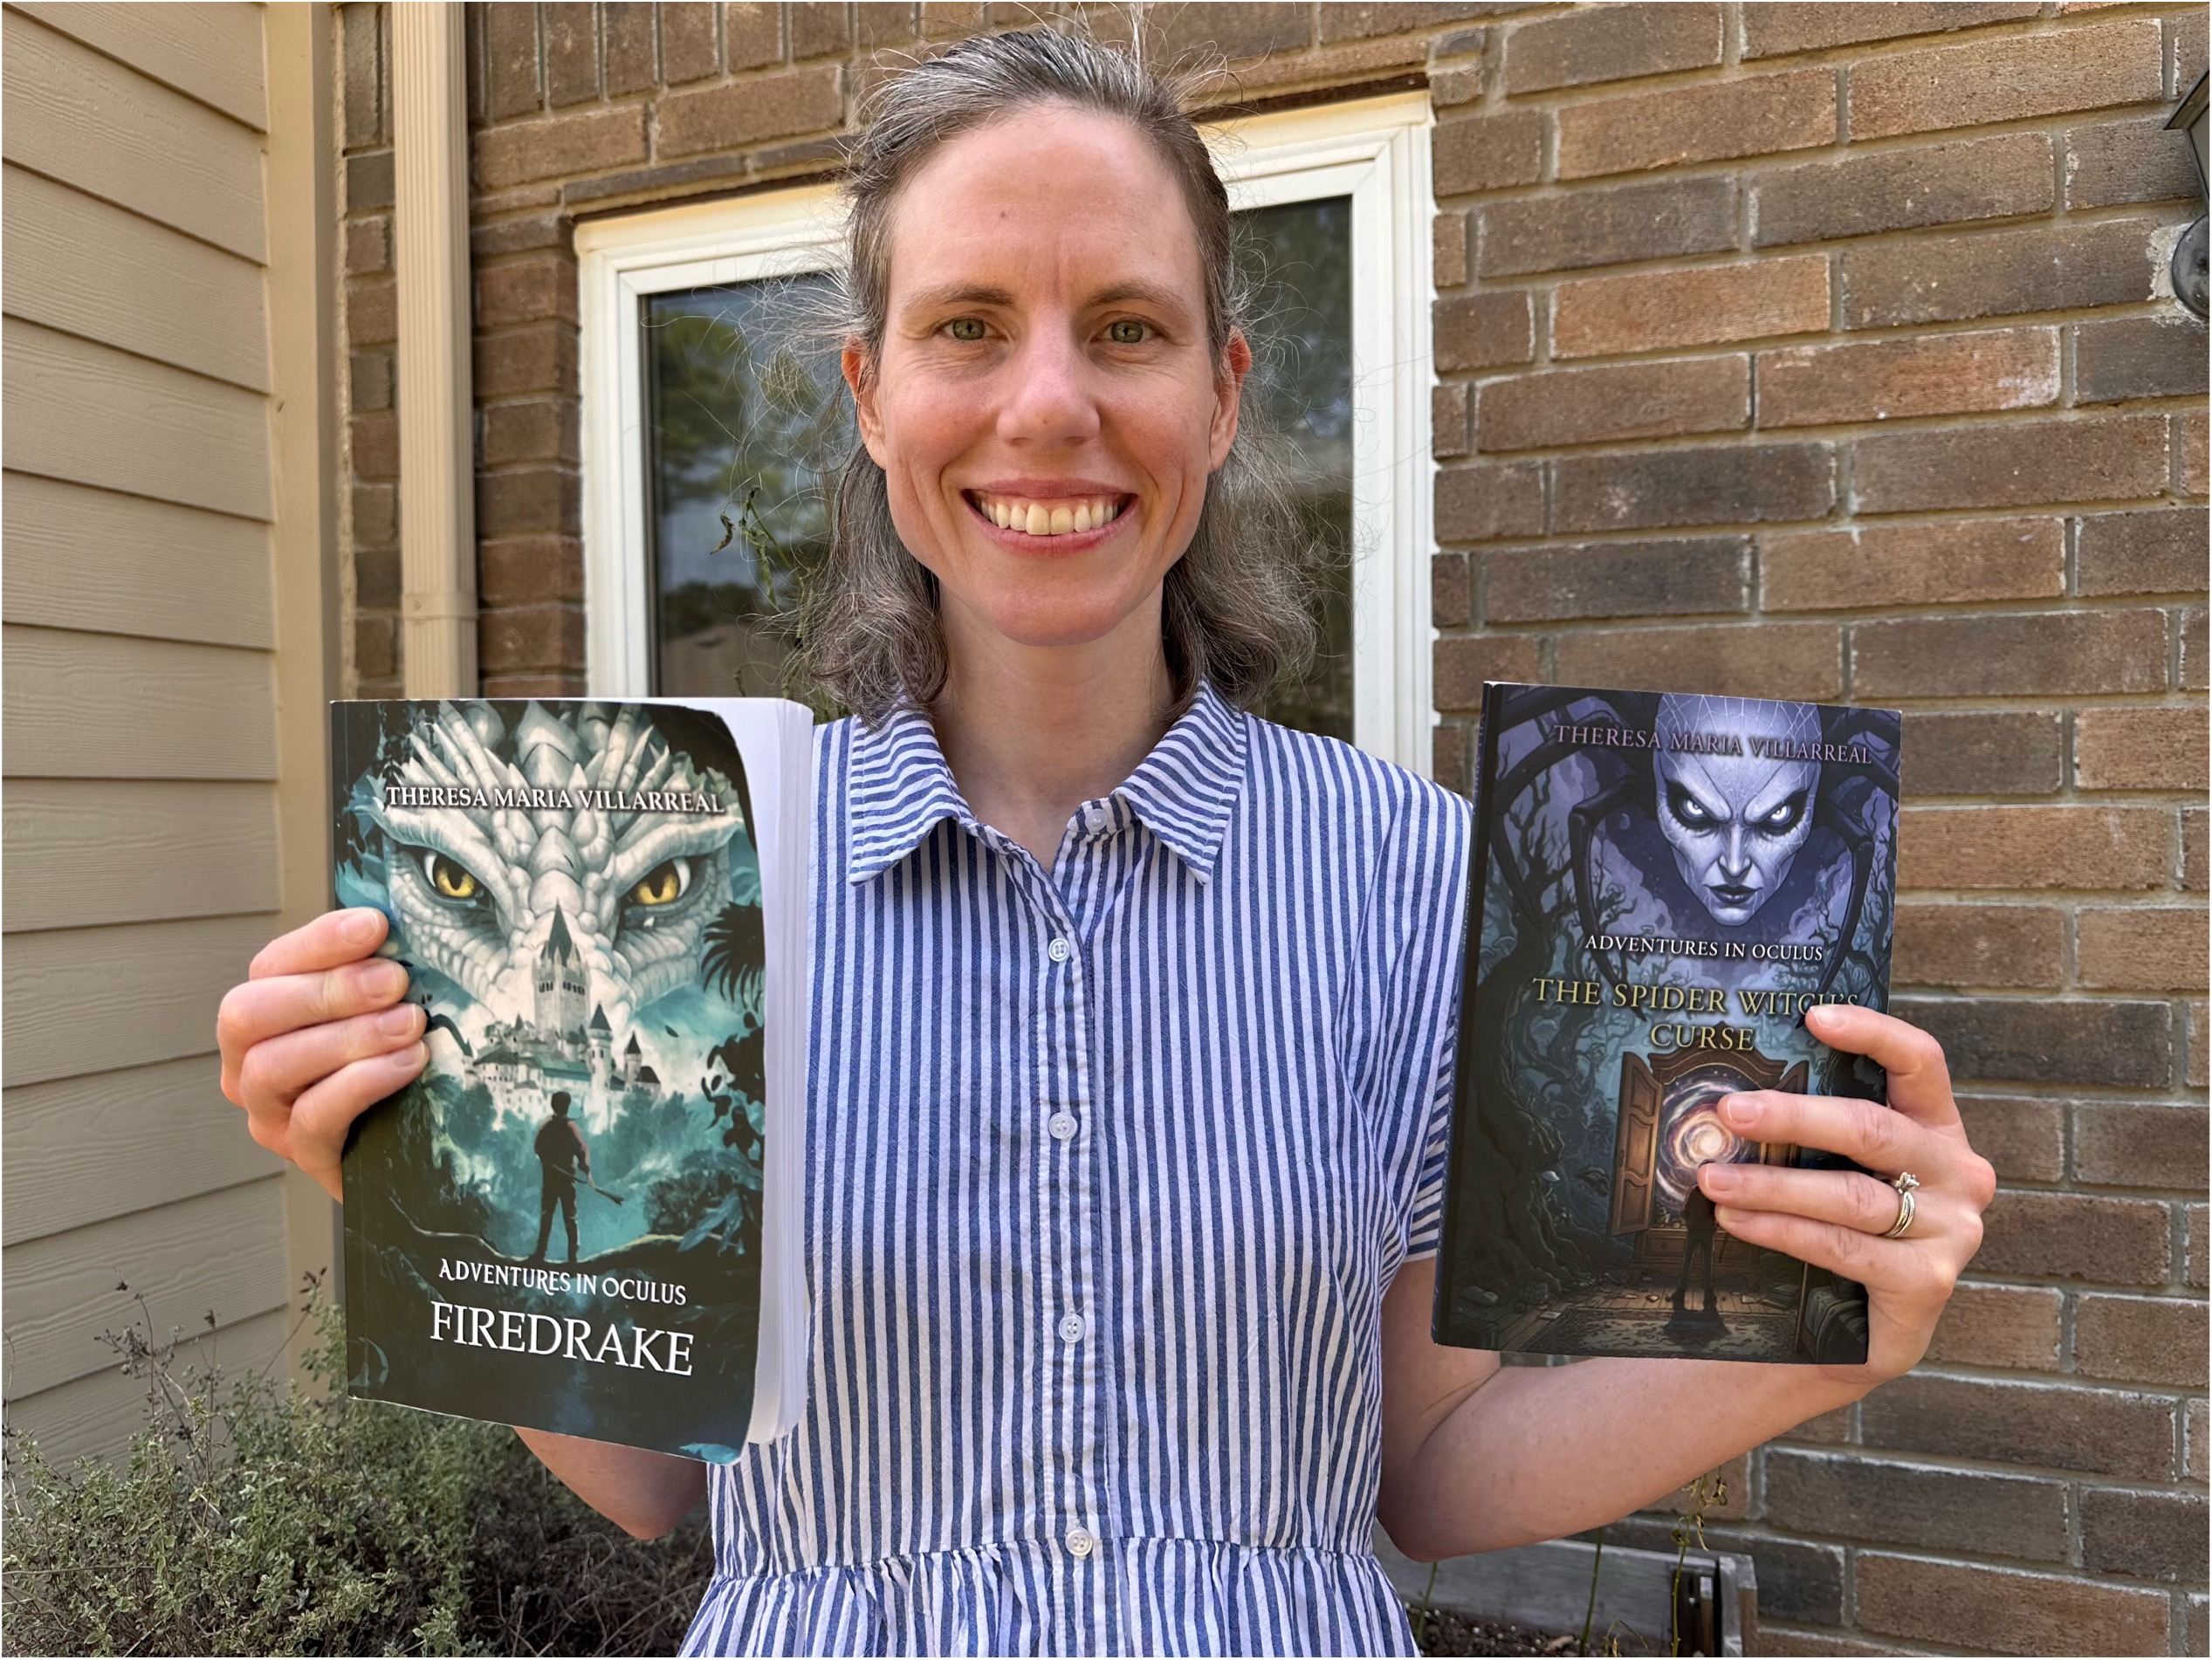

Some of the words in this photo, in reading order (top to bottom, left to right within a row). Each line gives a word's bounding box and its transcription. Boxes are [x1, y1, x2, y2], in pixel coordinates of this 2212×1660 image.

[1554, 724, 1662, 749] THERESA
[1671, 732, 1742, 755] MARIA
[1749, 738, 1872, 765] VILLARREAL
[386, 786, 488, 807] THERESA
[494, 788, 573, 808] MARIA
[579, 790, 725, 813] VILLARREAL
[1585, 935, 1718, 957] ADVENTURES
[1725, 943, 1746, 957] IN
[1751, 943, 1823, 960] OCULUS
[1532, 977, 1601, 1005] THE
[1613, 984, 1726, 1012] SPIDER
[1650, 1023, 1755, 1051] CURSE
[438, 1258, 571, 1296] ADVENTURES
[576, 1273, 598, 1295] IN
[602, 1277, 687, 1306] OCULUS
[429, 1300, 695, 1376] FIREDRAKE
